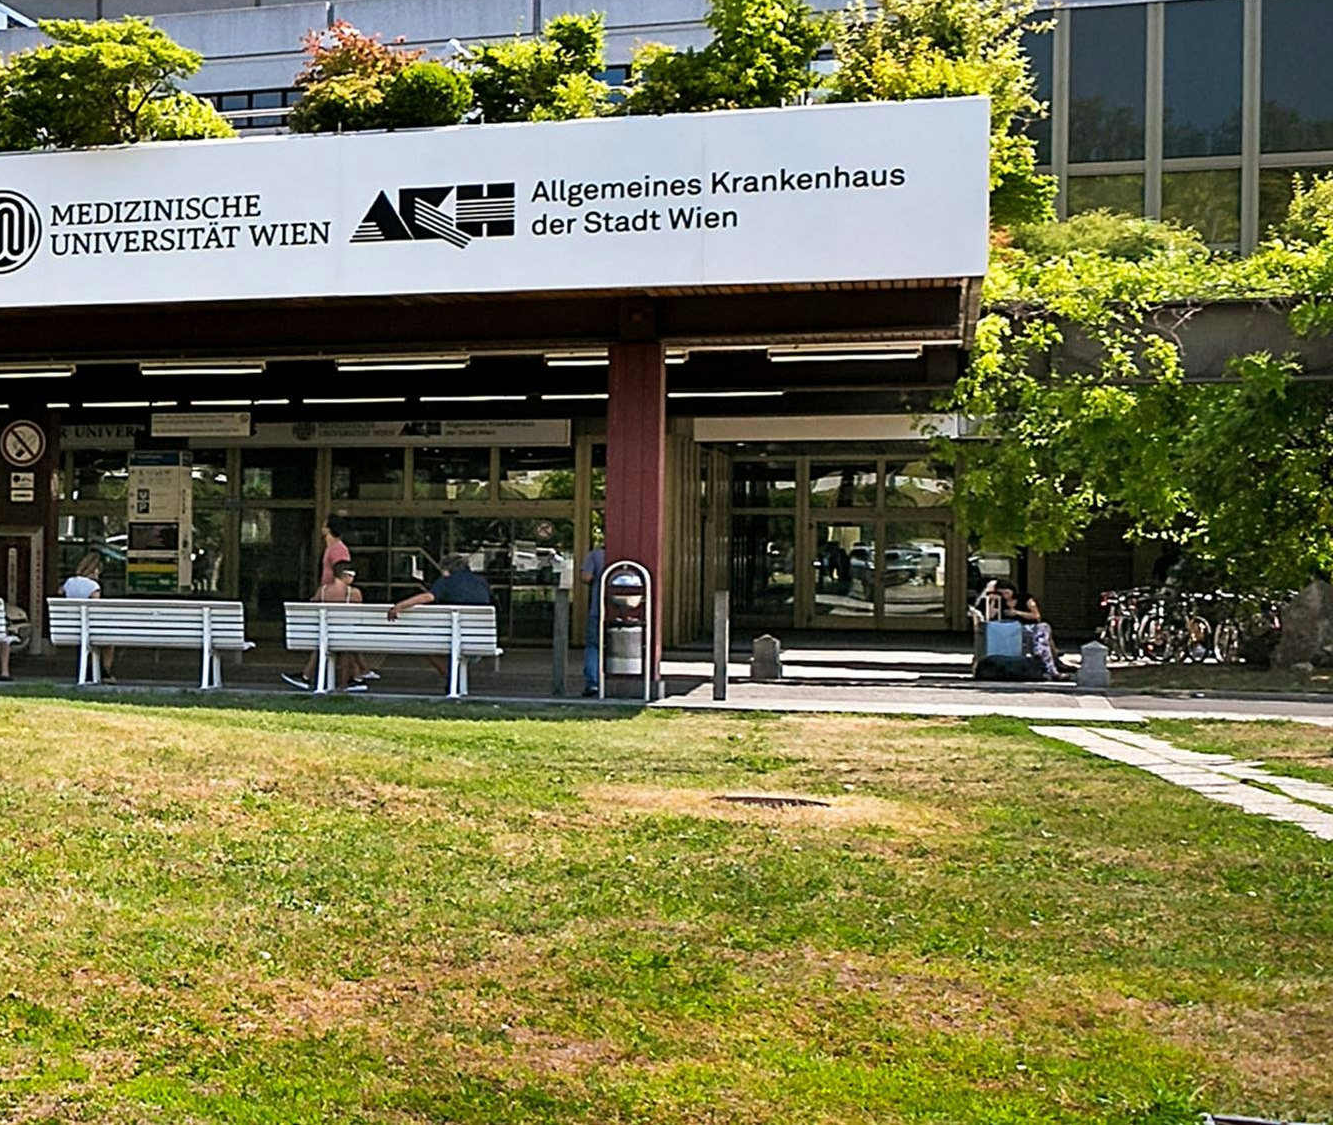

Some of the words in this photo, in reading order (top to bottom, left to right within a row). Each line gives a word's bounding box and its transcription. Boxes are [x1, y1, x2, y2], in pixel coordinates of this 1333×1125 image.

[531, 175, 702, 208] Allgemeines
[711, 165, 905, 195] Krankenhaus
[50, 194, 262, 227] MEDIZINISCHE
[531, 213, 577, 236] der
[583, 208, 661, 234] Stadt
[668, 206, 738, 230] Wien
[50, 221, 241, 256] UNIVERSITÄT
[248, 222, 331, 247] WIEN
